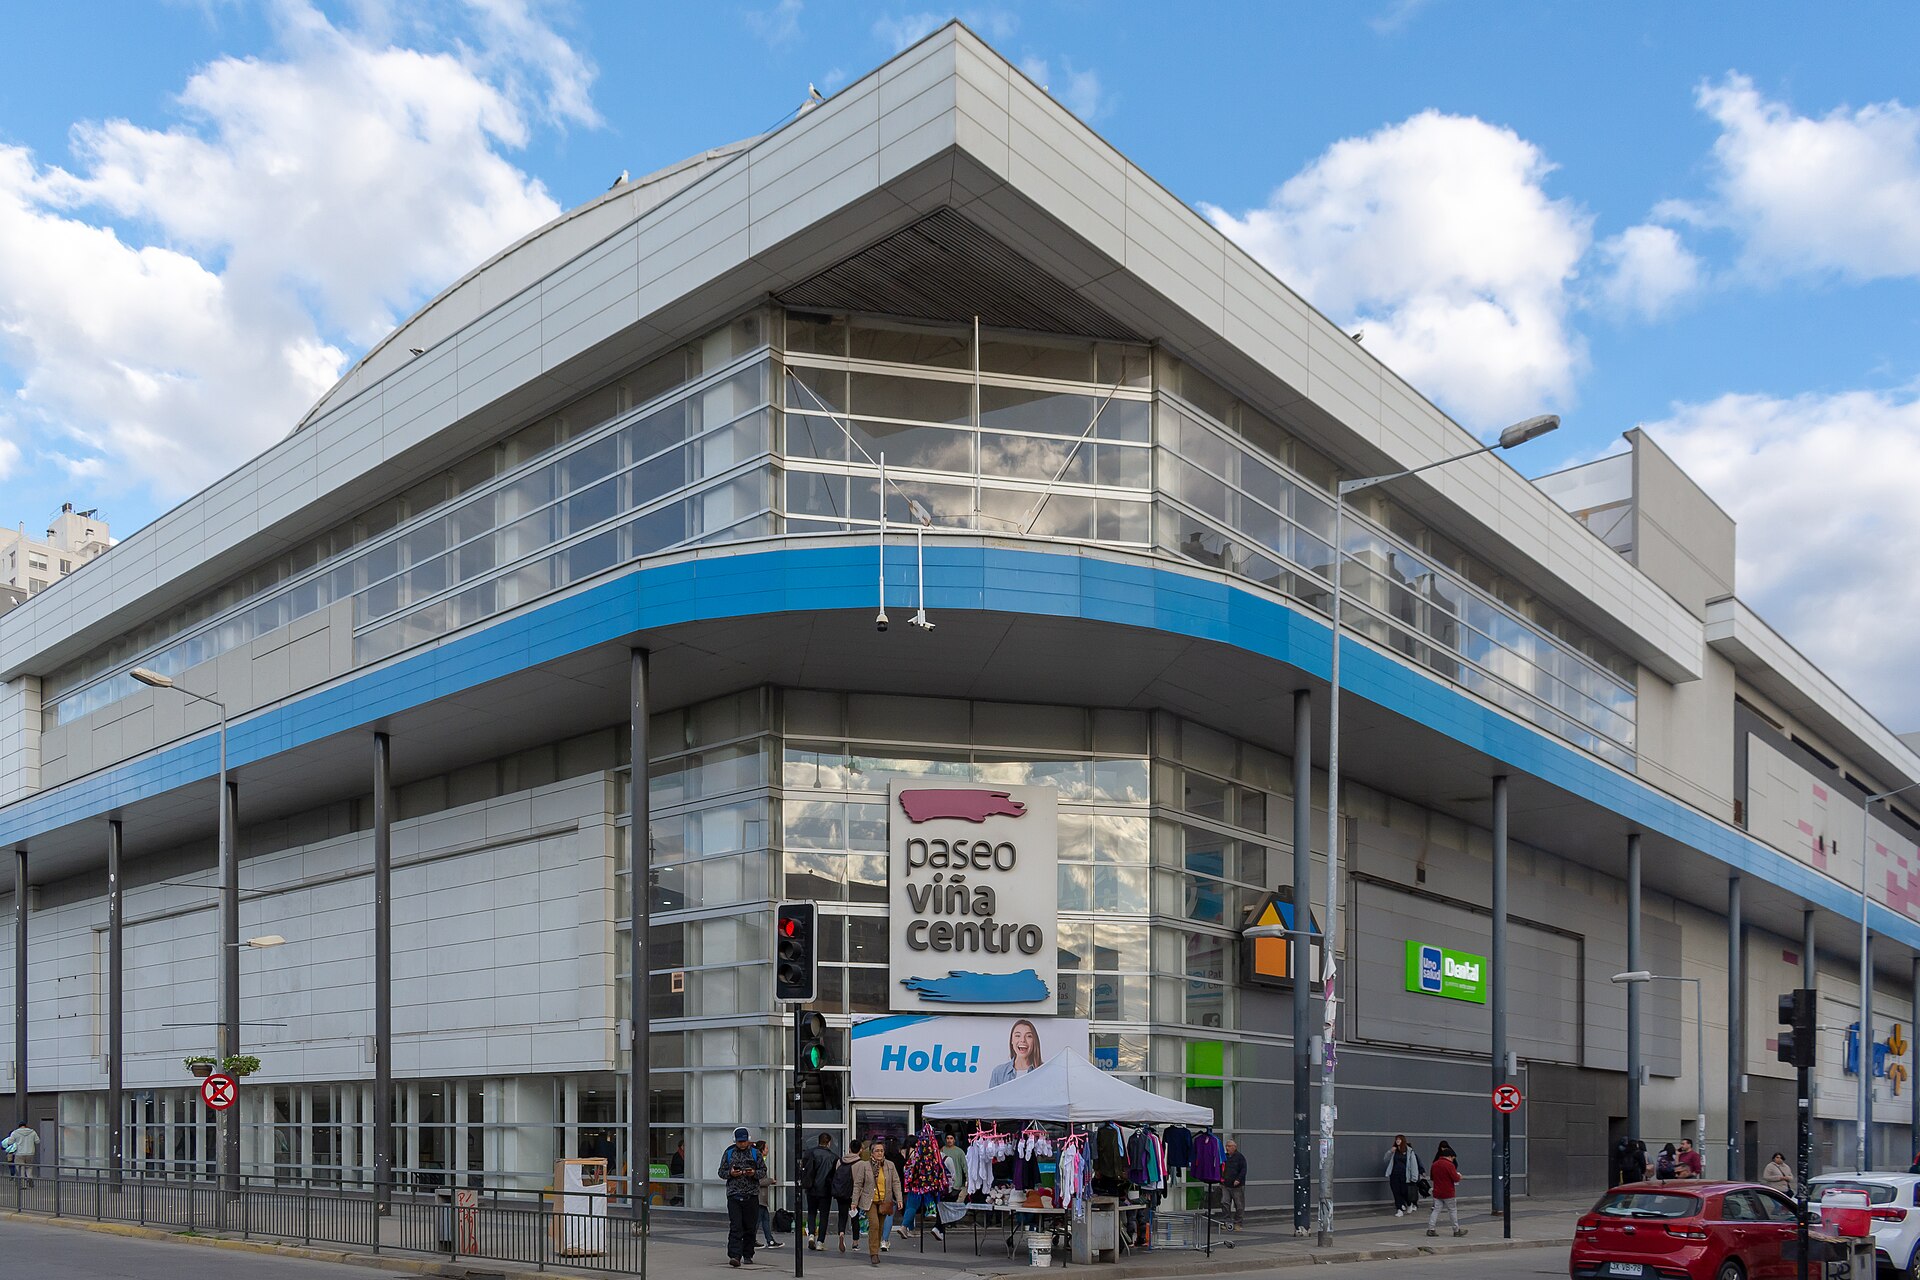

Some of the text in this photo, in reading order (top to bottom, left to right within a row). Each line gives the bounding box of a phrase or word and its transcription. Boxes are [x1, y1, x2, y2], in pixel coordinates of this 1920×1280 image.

[906, 837, 1017, 877] paseo
[906, 872, 996, 915] viña
[906, 918, 1043, 954] centro
[1445, 957, 1479, 981] Dental
[880, 1044, 980, 1073] Hola!
